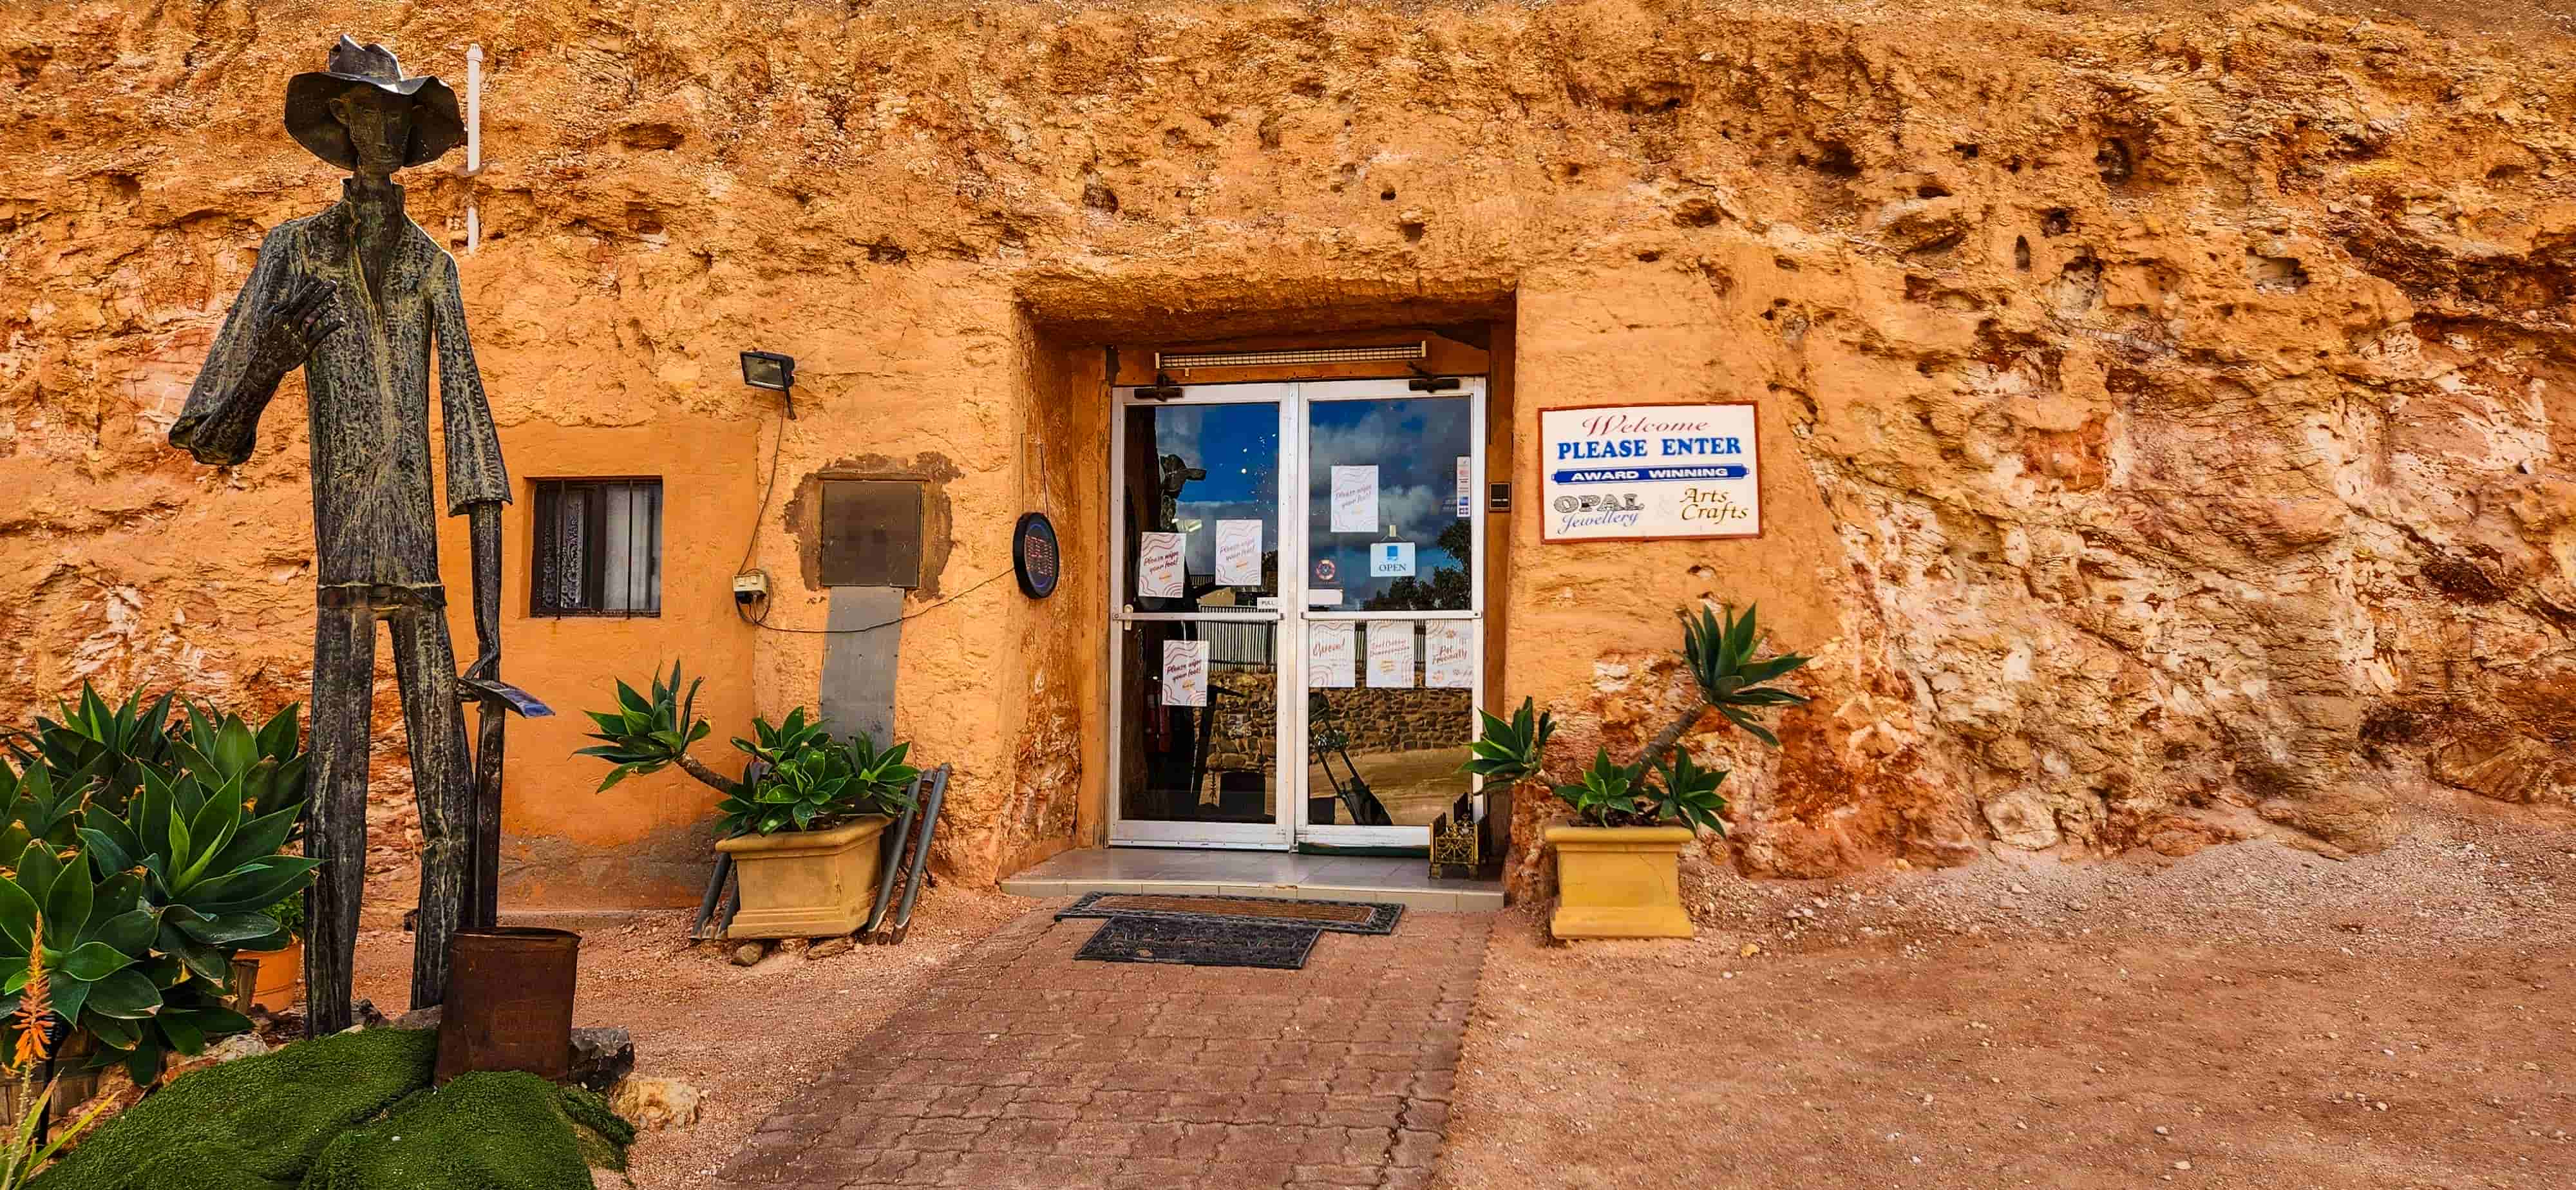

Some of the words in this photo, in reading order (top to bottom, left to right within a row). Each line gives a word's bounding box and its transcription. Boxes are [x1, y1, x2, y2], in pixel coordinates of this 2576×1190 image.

[1582, 415, 1710, 437] Welcome
[1558, 439, 1647, 460] PLEASE
[1662, 437, 1741, 455] ENTER
[1571, 471, 1638, 481] AWARD
[1649, 468, 1728, 478] WINNING
[1553, 494, 1645, 513] OPAL
[1680, 488, 1728, 504] Arts
[1557, 511, 1638, 534] Jewellery
[1681, 502, 1748, 525] Crafts
[1379, 563, 1406, 572] OPEN
